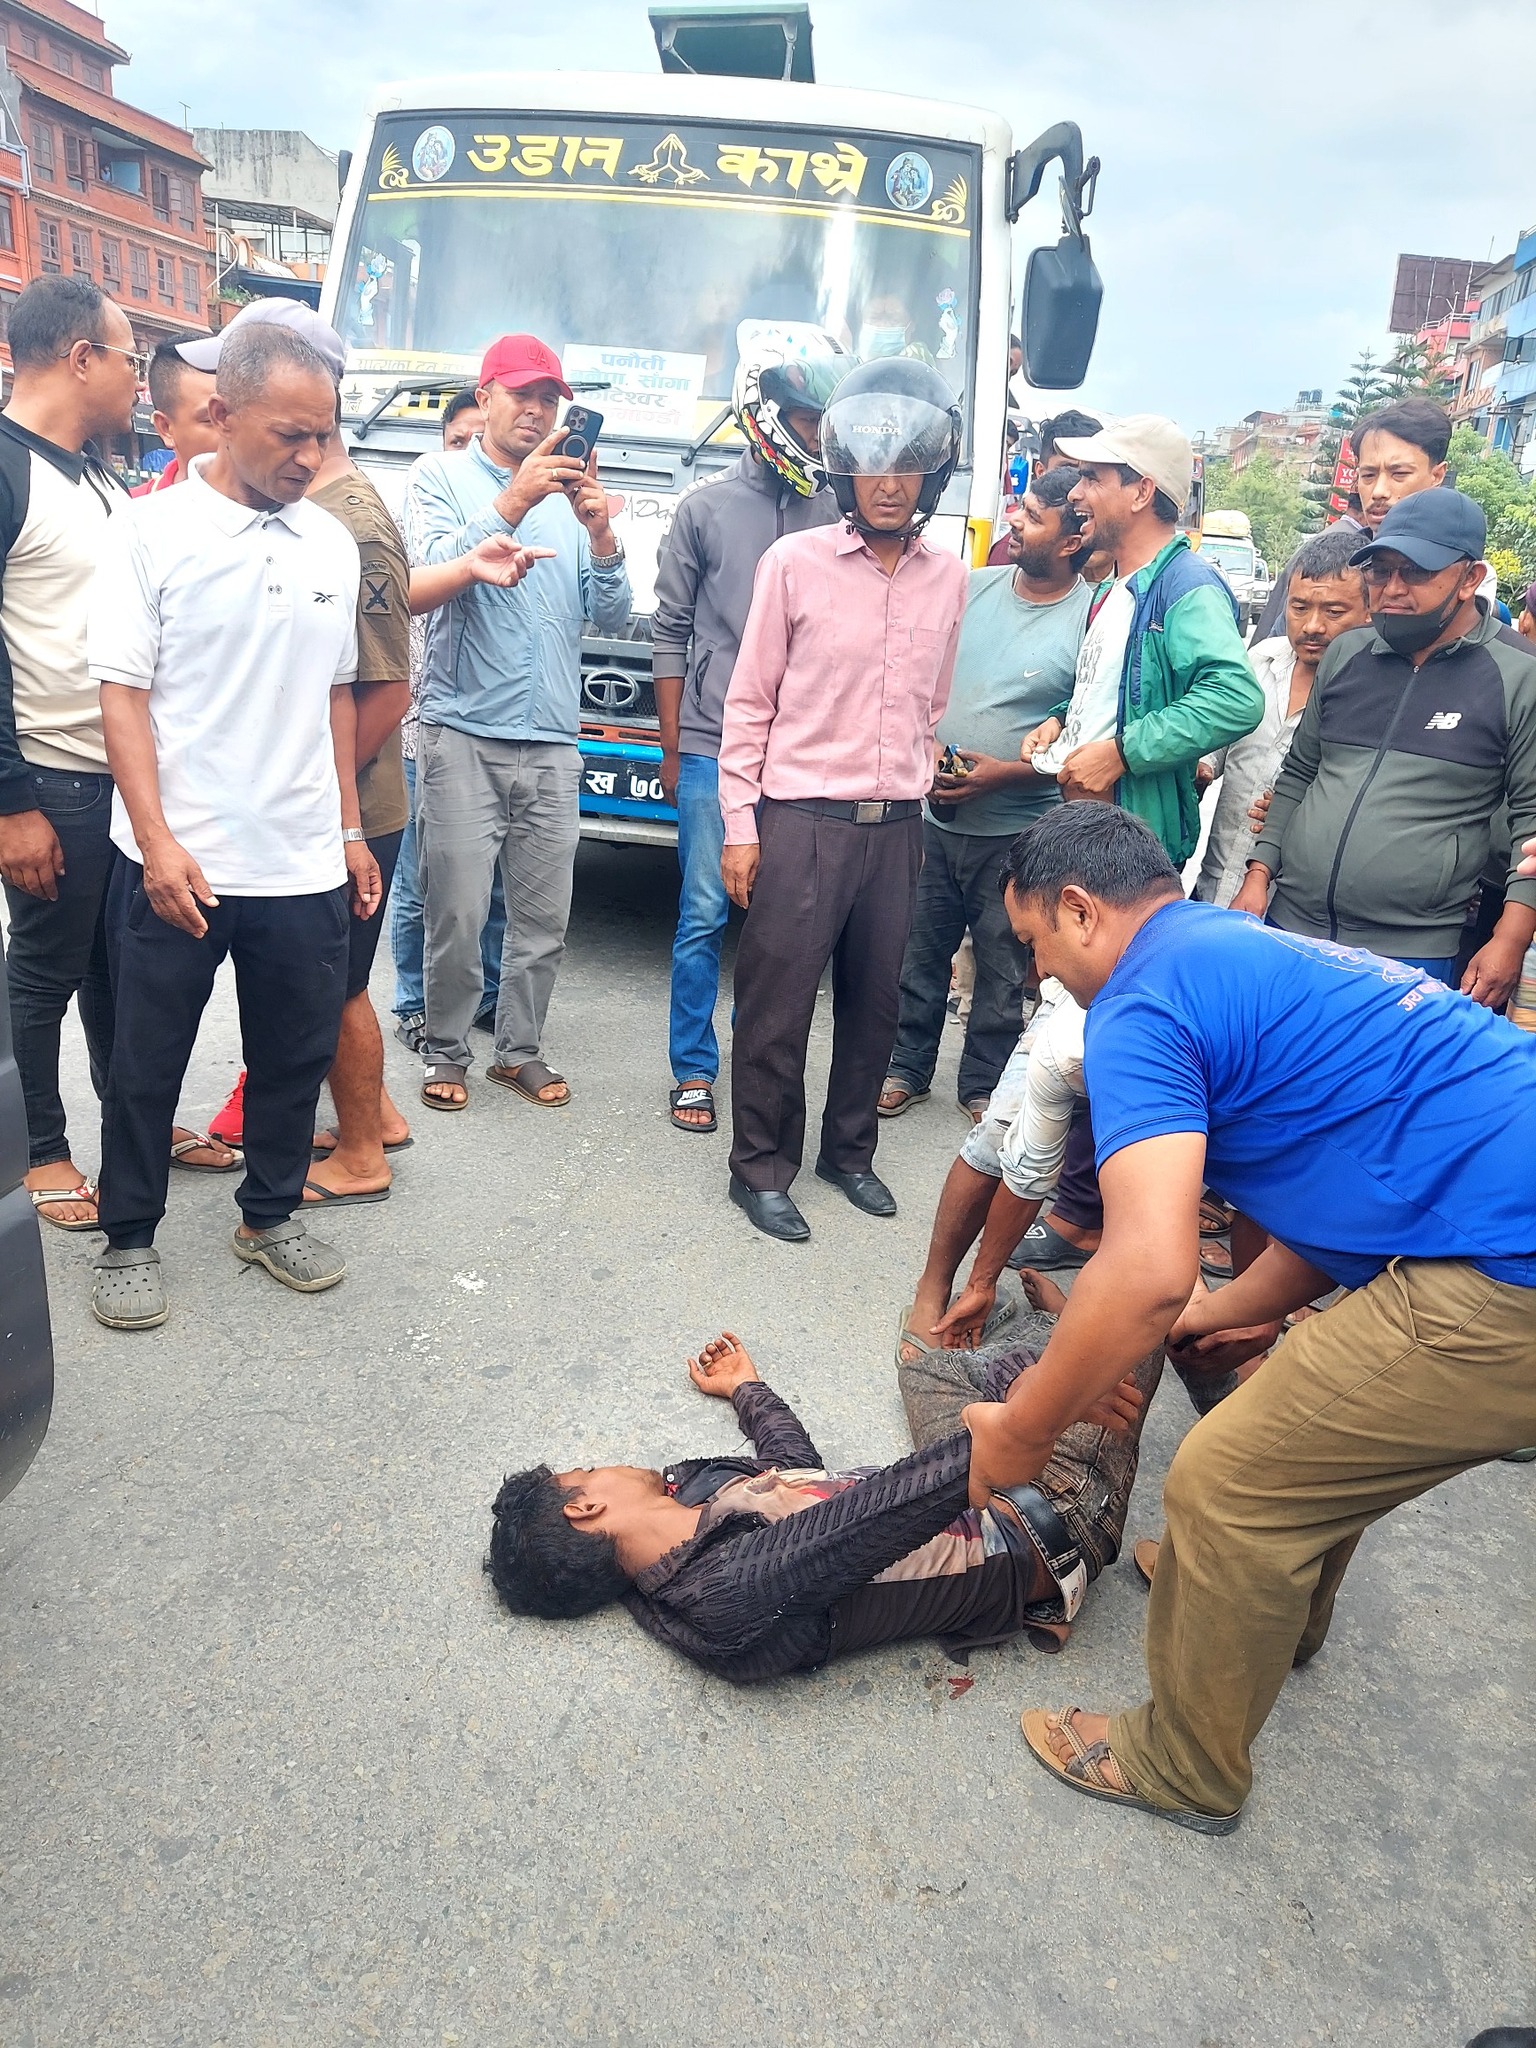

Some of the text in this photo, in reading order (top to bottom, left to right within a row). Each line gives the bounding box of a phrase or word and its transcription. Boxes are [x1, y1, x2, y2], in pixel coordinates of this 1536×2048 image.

[466, 134, 869, 198] उडान काभ्रे
[601, 351, 667, 371] पनौती
[851, 425, 902, 436] HONDA
[585, 770, 618, 796] ख
[681, 1089, 708, 1100] NIKE
